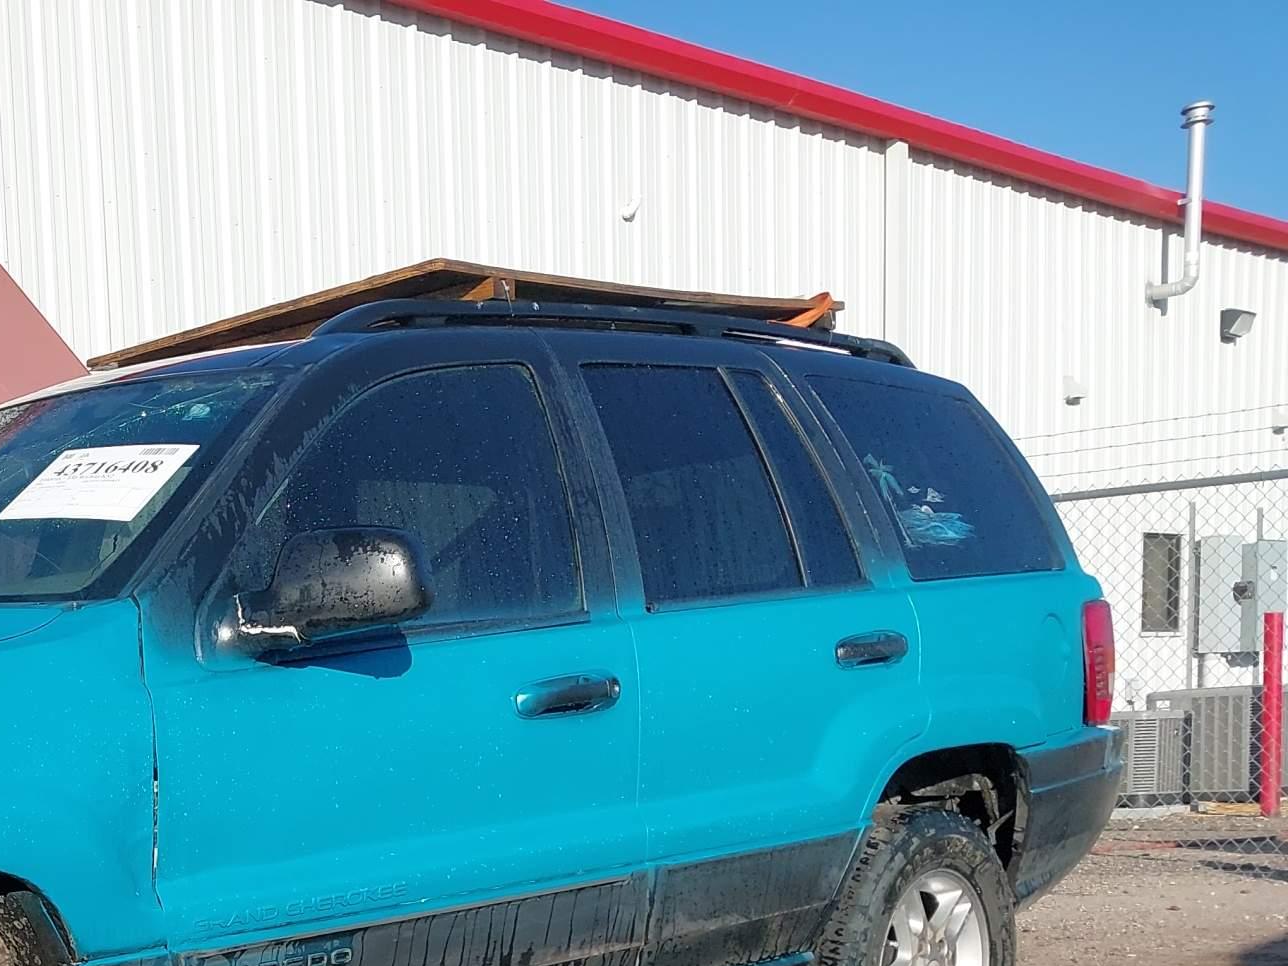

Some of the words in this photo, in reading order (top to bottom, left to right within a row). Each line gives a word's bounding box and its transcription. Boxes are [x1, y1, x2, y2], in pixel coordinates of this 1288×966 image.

[54, 460, 164, 476] 43716408
[195, 906, 279, 930] GRAND
[286, 882, 408, 917] CHEROKEE
